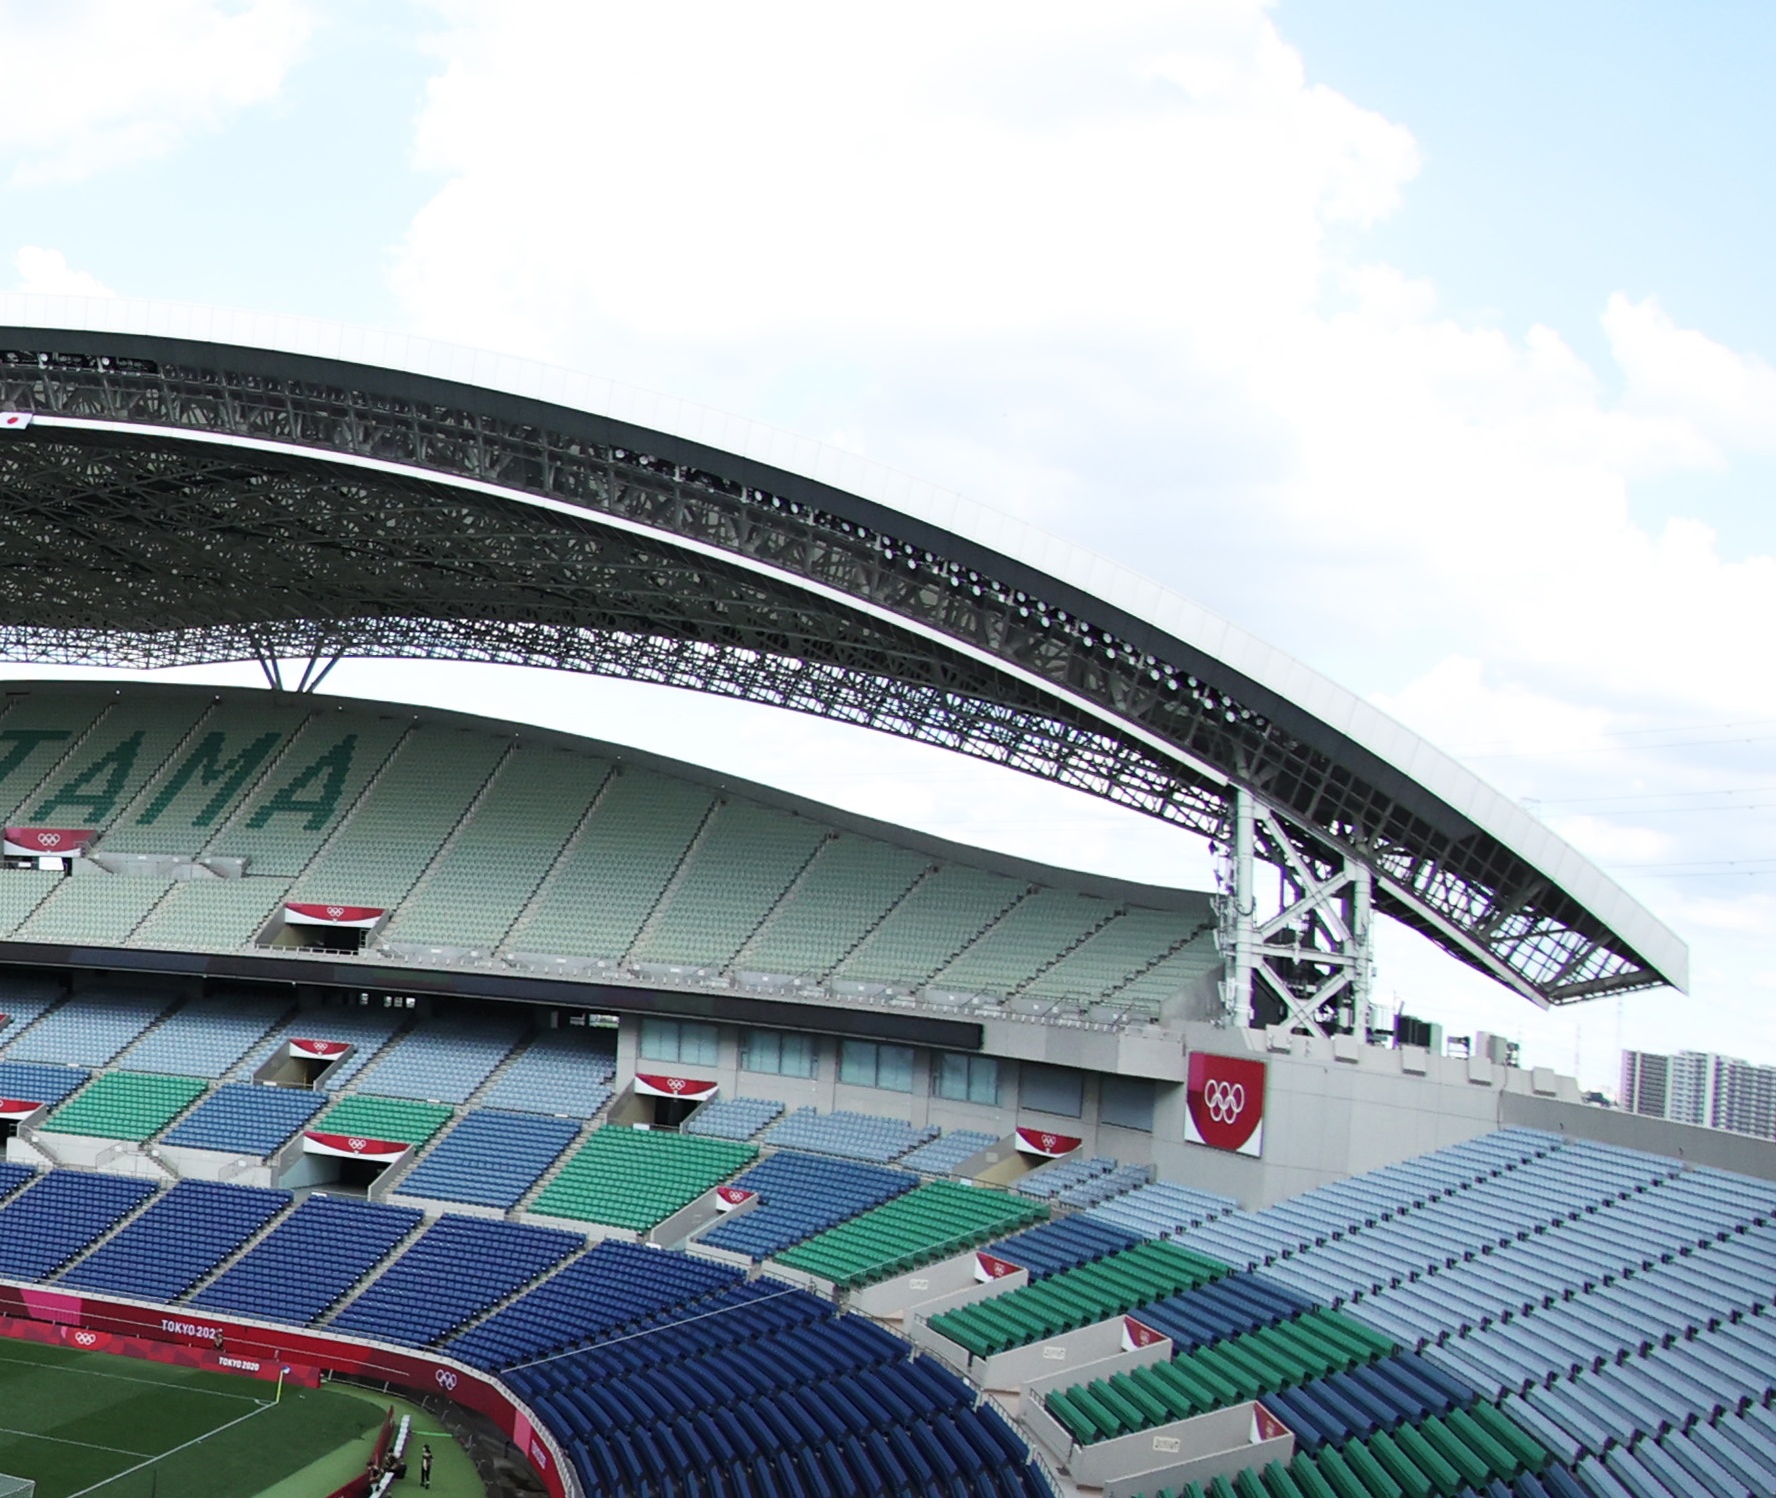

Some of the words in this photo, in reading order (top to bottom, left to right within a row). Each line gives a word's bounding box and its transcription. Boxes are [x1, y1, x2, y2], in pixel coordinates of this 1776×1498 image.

[161, 1319, 195, 1336] TOKYO
[196, 1326, 217, 1339] 202
[219, 1356, 242, 1368] TOKYO
[242, 1360, 260, 1372] 2020
